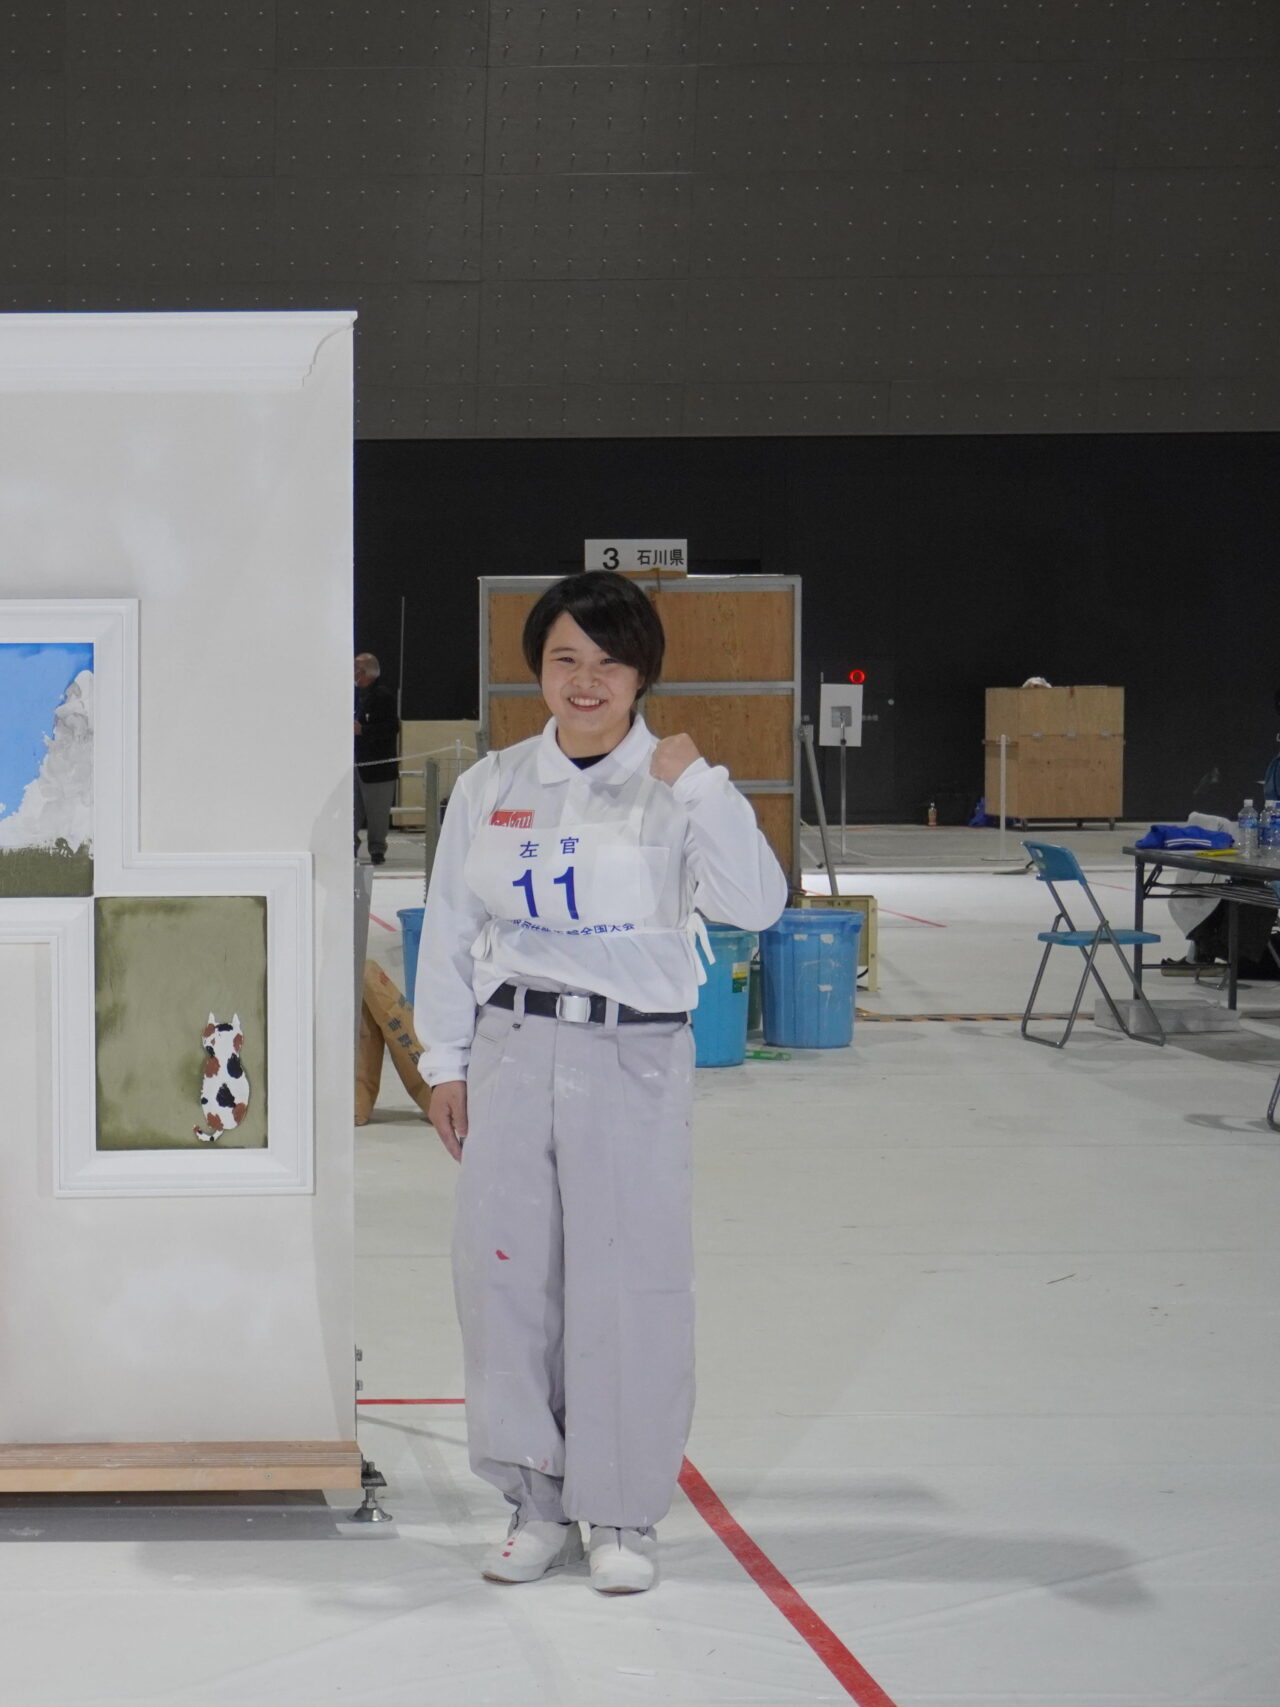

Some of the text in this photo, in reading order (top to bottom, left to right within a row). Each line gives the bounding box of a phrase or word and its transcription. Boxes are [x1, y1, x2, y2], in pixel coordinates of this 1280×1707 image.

[602, 547, 685, 570] 3 石川県
[512, 866, 580, 920] 11
